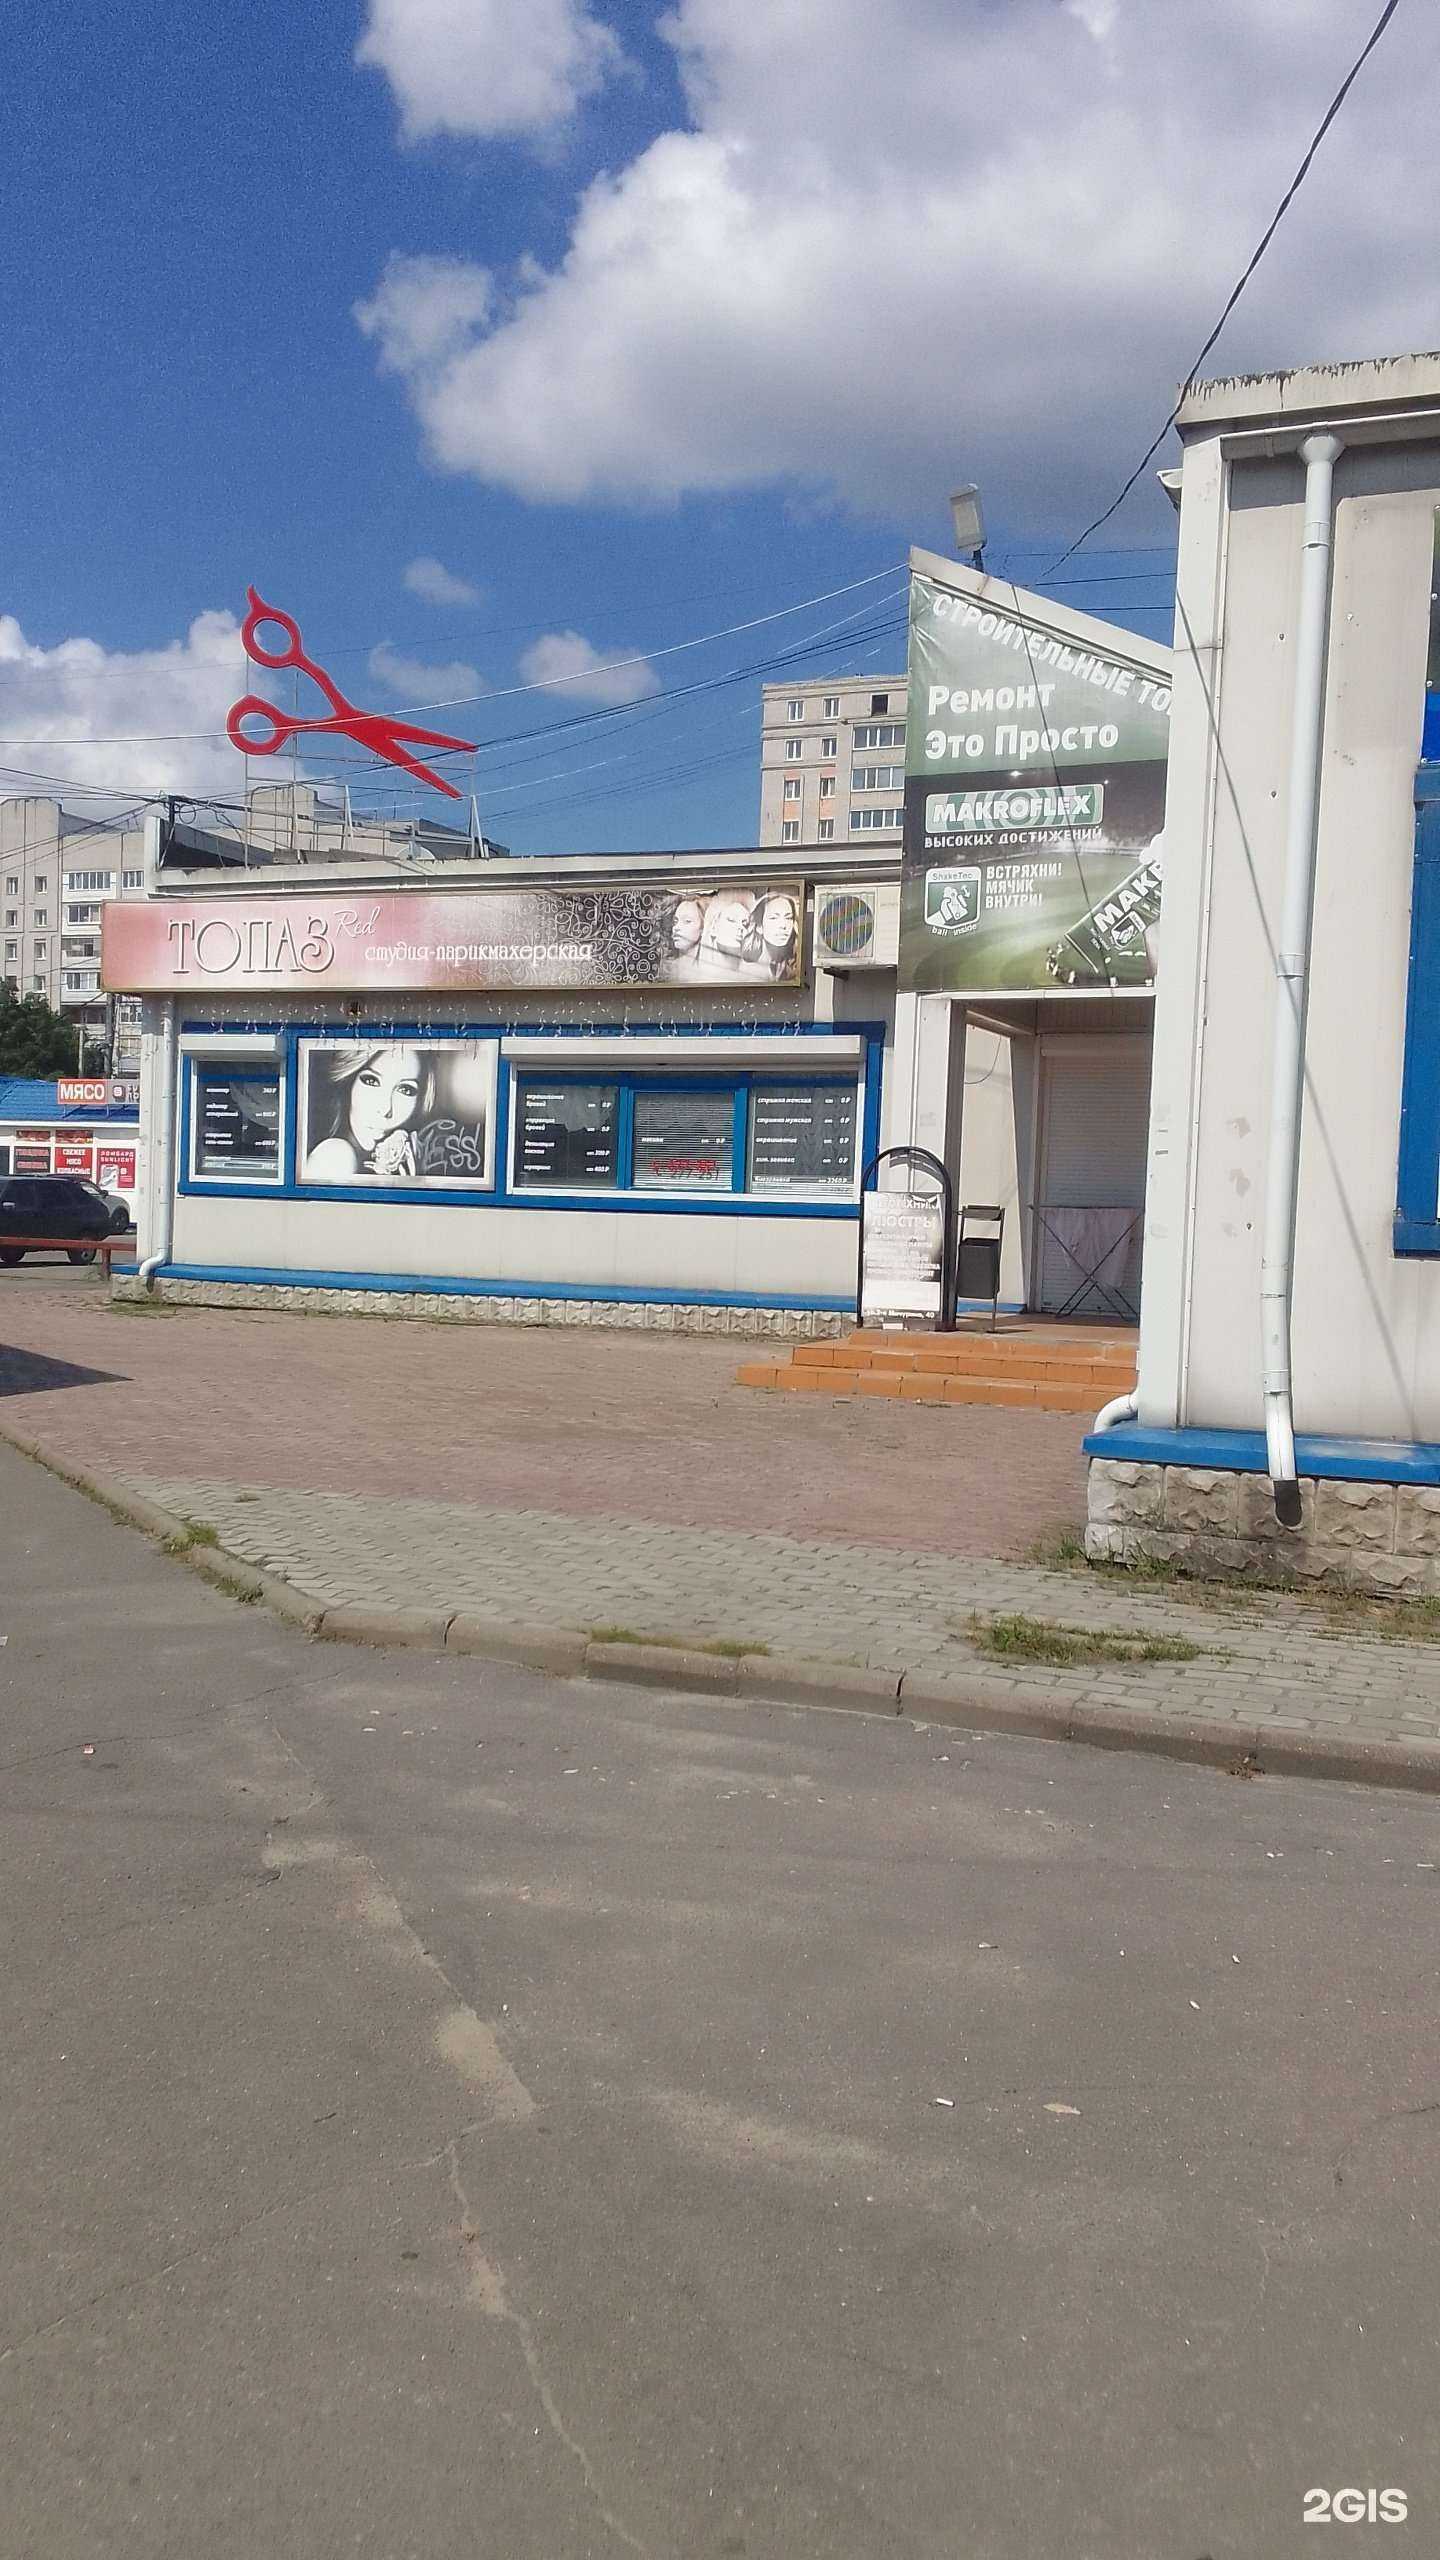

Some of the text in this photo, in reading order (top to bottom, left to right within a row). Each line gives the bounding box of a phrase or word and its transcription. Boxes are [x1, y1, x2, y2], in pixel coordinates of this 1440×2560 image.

[933, 593, 1172, 716] СТРОИТЕЛЬНЫЕ ТО
[928, 683, 1056, 716] Ремонт
[925, 724, 1119, 760] Это Просто
[932, 794, 1092, 823] MAKROFLEX
[924, 827, 1103, 848] ВЫСОКИХ ДОСТИЖЕНИЙ
[986, 862, 1063, 879] ВСТРЯХНИ!
[986, 877, 1034, 893] МЯЧИК
[334, 906, 382, 938] Red
[168, 917, 335, 974] ТОПАЗ
[364, 941, 592, 968] студия-парикмахерская
[60, 1083, 106, 1100] МЯСО
